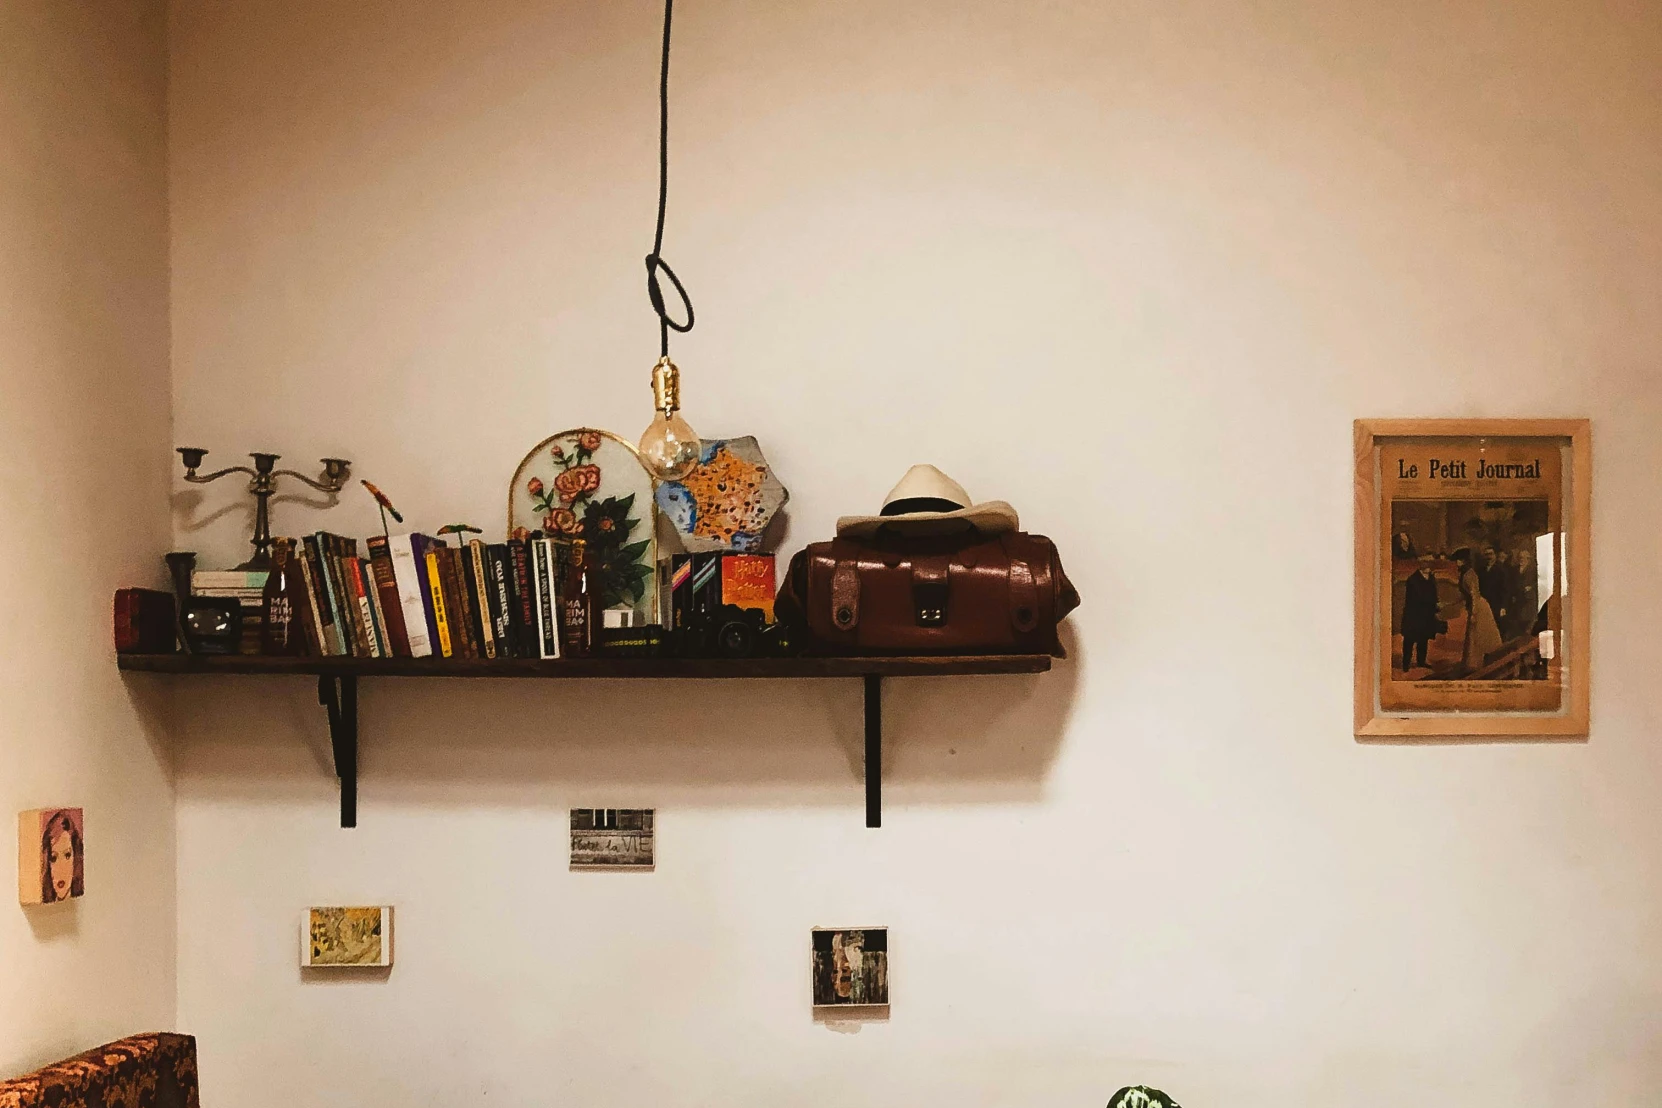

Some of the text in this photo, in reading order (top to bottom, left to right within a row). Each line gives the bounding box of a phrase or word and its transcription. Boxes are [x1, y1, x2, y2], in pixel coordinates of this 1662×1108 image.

[1398, 458, 1541, 479] Le Petit Journal
[622, 834, 653, 853] VIE
